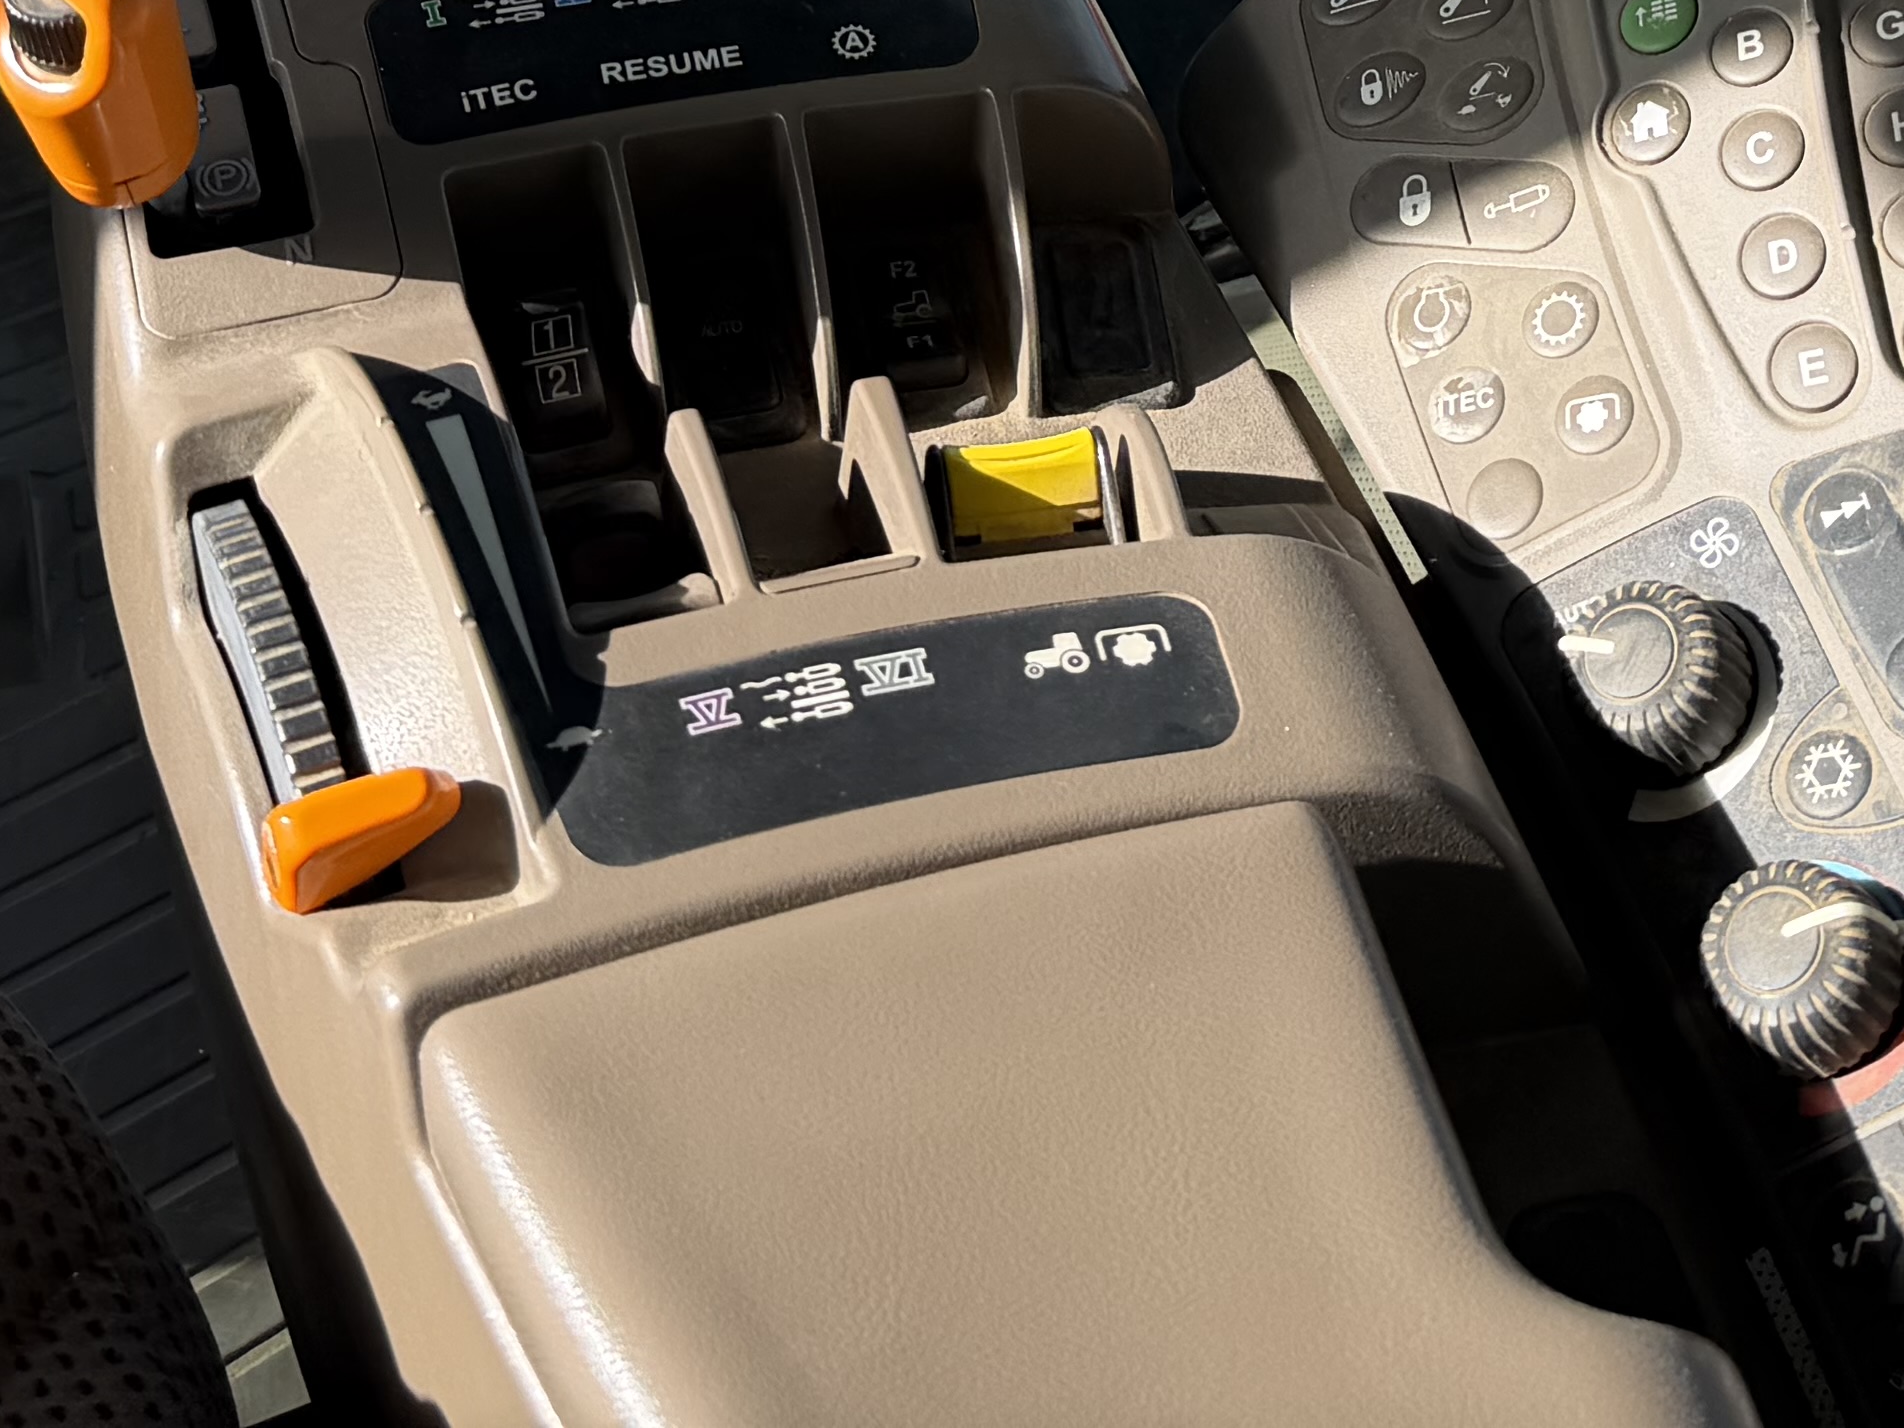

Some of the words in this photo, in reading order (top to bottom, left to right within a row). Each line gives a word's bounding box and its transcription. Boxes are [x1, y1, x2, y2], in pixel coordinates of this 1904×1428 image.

[1735, 28, 1765, 62] B
[460, 77, 538, 114] iTEC
[600, 44, 744, 85] RESUME
[1746, 130, 1775, 165] C
[284, 233, 314, 266] N
[1767, 238, 1798, 275] D
[889, 260, 918, 279] F2
[1798, 347, 1829, 388] E
[853, 647, 935, 697] VI
